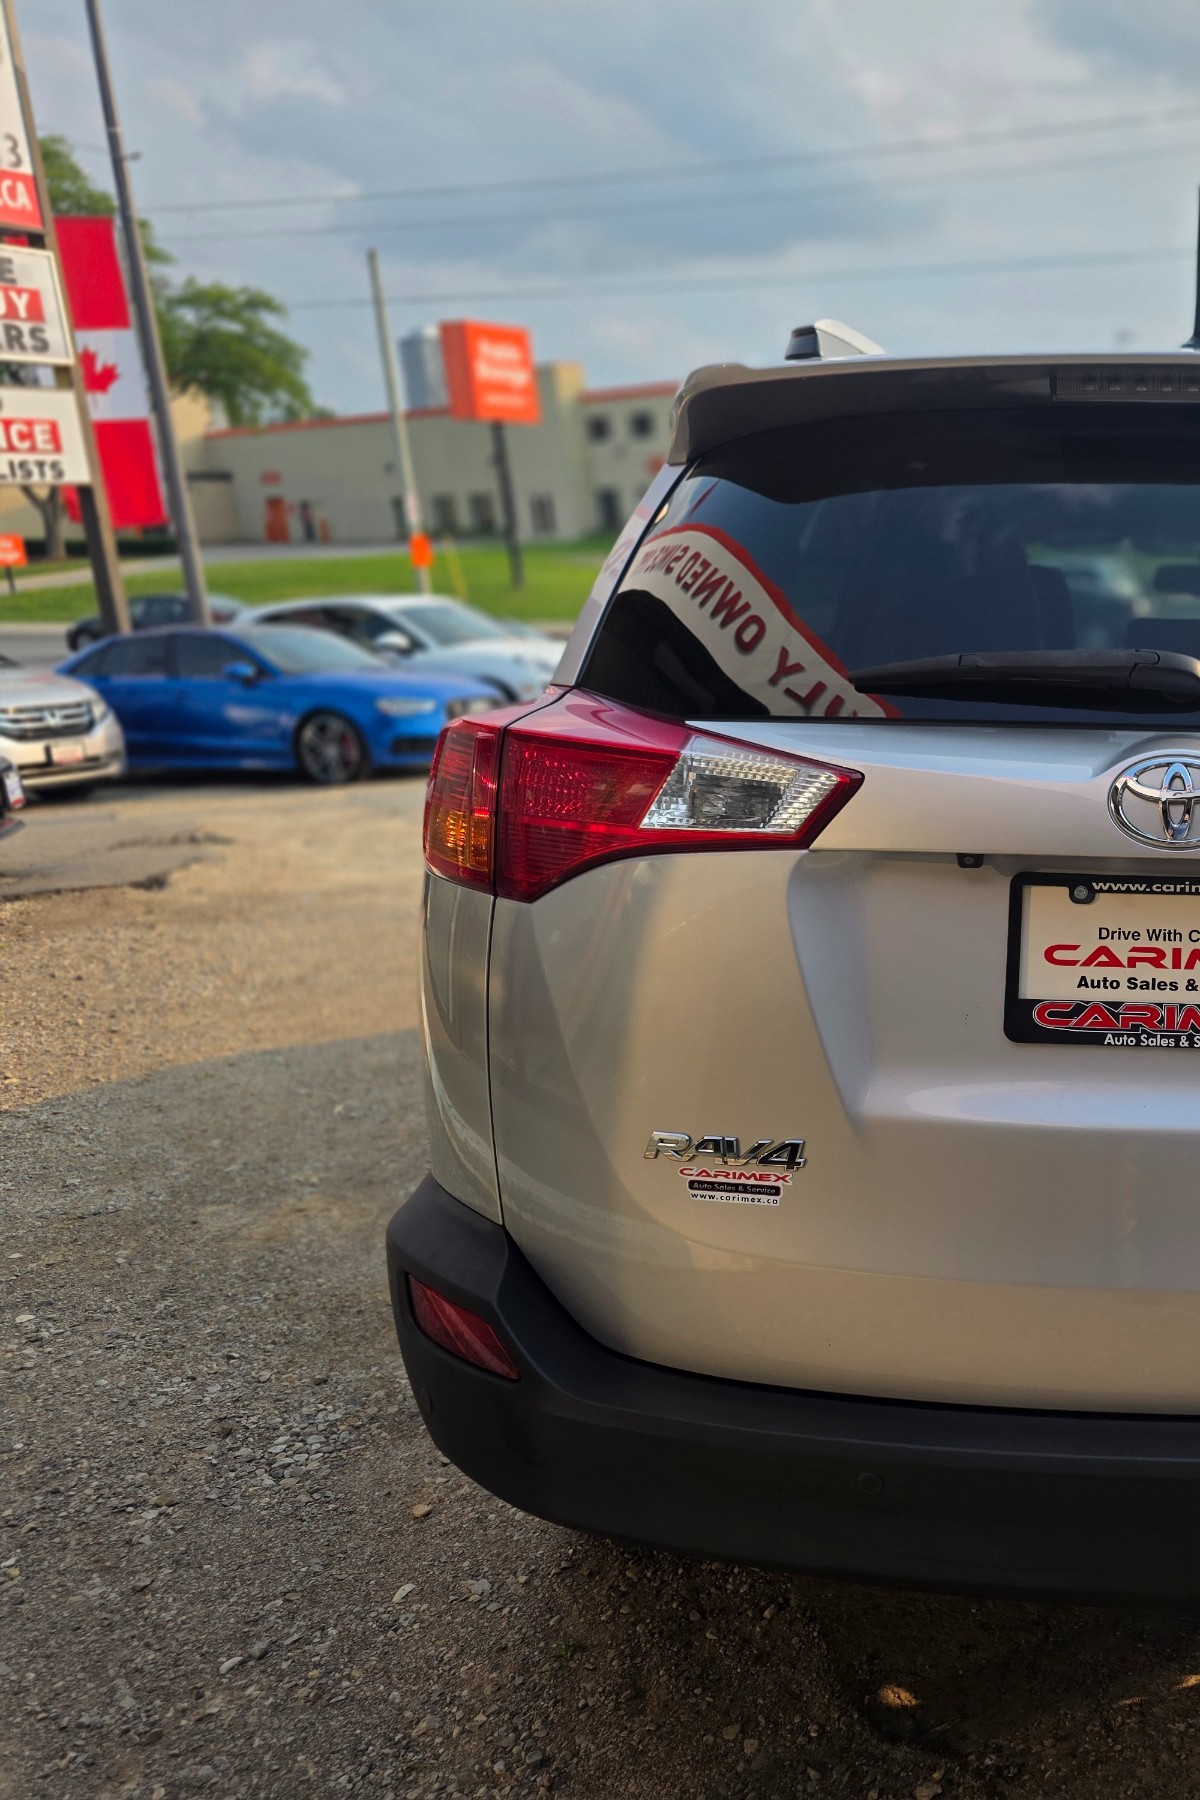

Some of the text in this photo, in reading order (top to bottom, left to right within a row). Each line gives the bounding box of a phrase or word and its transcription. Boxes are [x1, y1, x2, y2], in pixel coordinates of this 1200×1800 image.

[0, 323, 49, 353] RS
[0, 459, 64, 481] ISTS
[1098, 927, 1141, 941] Drive
[1146, 928, 1183, 943] With
[1077, 975, 1120, 991] Auto
[1126, 977, 1179, 992] Sales
[1185, 979, 1199, 993] &
[1104, 1033, 1136, 1047] Auto
[1140, 1034, 1175, 1048] Sales
[1179, 1035, 1190, 1048] &
[643, 1130, 808, 1172] RAV4
[679, 1168, 792, 1184] CARIMEX
[693, 1181, 712, 1190] Auto
[714, 1183, 736, 1192] Sales
[746, 1185, 776, 1194] Service
[690, 1192, 778, 1205] www.carimex.ca
